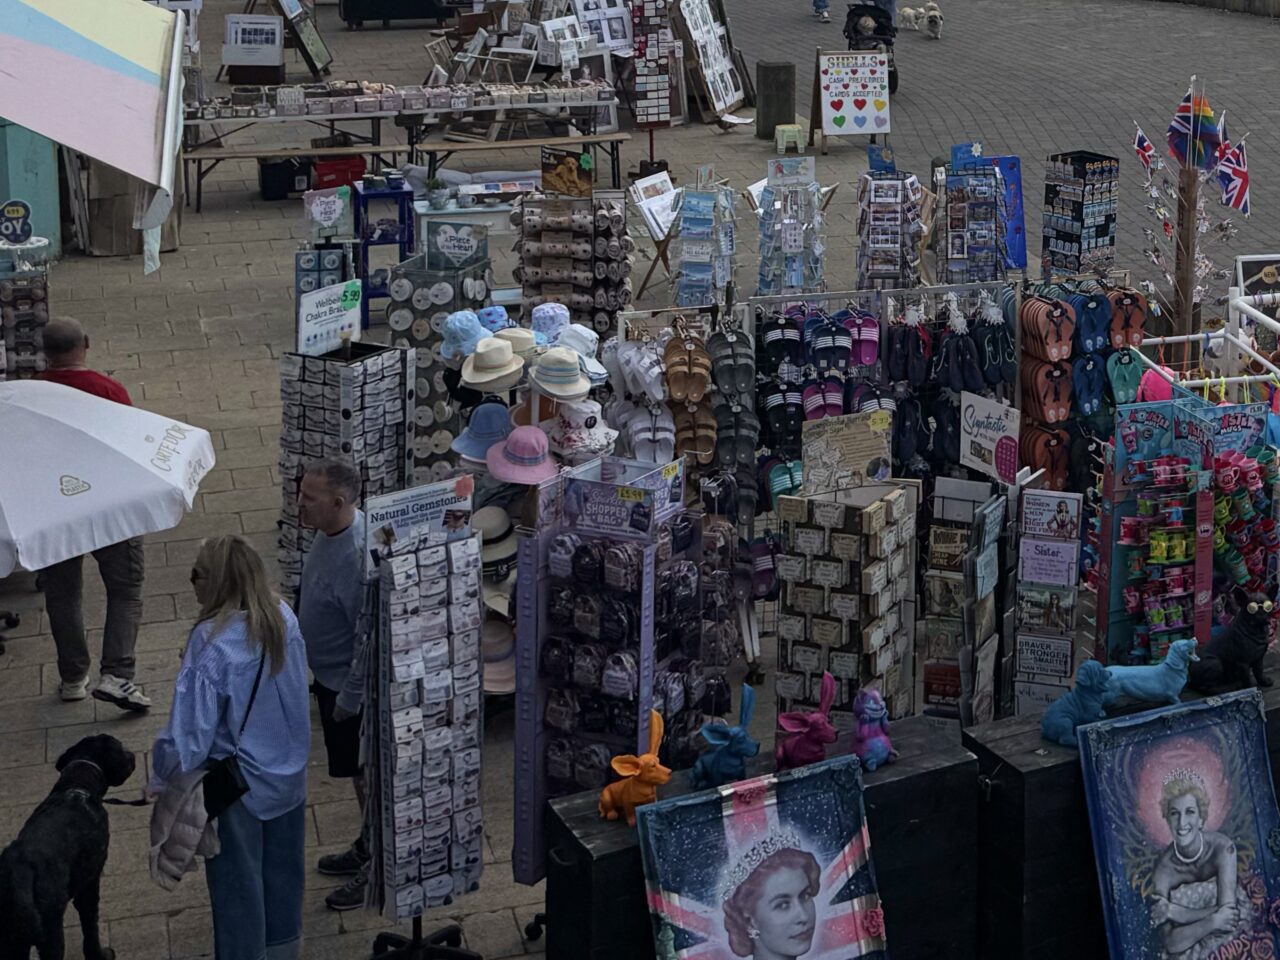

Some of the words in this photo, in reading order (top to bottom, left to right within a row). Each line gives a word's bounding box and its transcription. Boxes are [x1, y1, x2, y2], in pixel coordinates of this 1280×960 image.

[827, 56, 878, 68] SHELLS
[453, 242, 473, 251] Heart
[306, 311, 327, 323] Chakra
[1220, 426, 1242, 435] MUGS
[370, 504, 410, 523] Natural
[411, 495, 468, 513] Gemstones
[1025, 500, 1051, 508] WOMEN
[586, 504, 628, 519] SHOPPER
[597, 514, 617, 525] BAG
[1034, 544, 1062, 558] Sister
[1019, 641, 1052, 650] BRAVER
[1019, 648, 1068, 658] STRONGER
